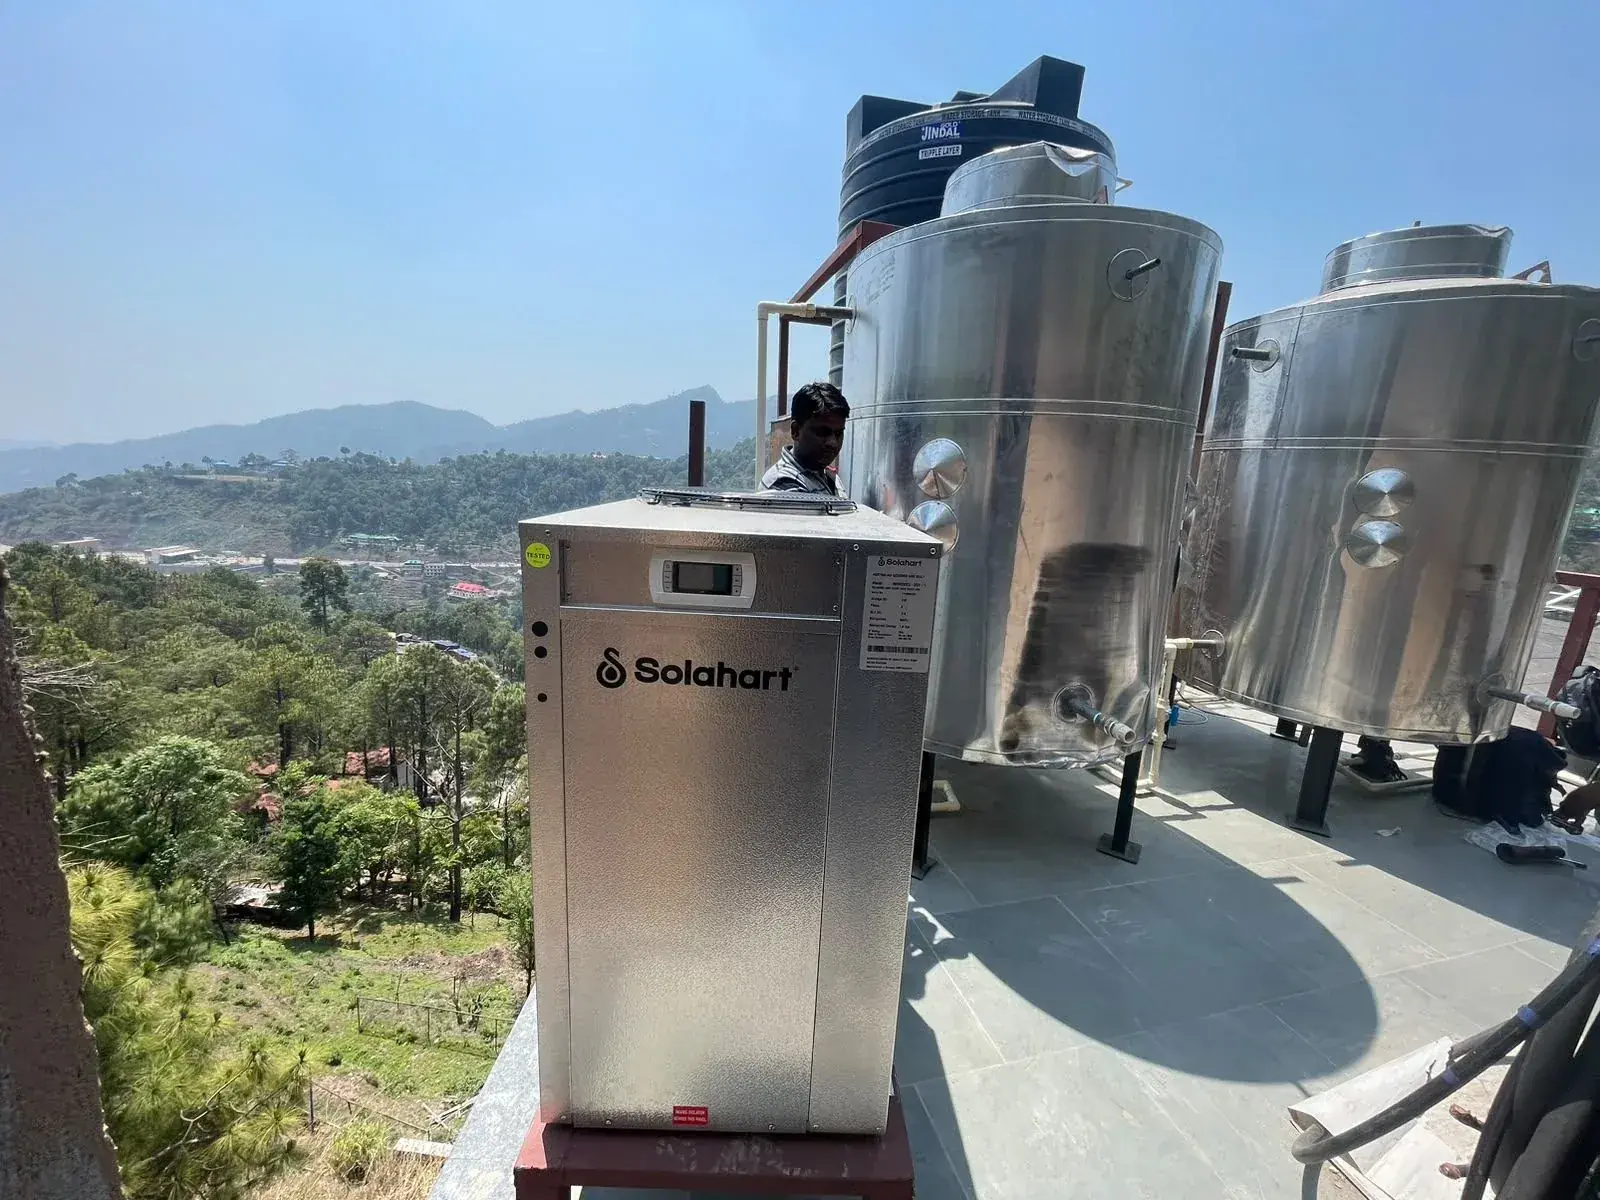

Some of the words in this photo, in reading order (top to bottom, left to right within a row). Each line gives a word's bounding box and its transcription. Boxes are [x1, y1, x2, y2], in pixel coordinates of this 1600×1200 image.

[1018, 111, 1035, 120] WATER
[921, 126, 960, 141] JINDAL
[922, 147, 943, 158] TRIPPLE
[943, 145, 961, 156] LAYER
[526, 551, 551, 560] TESTED
[886, 558, 922, 567] Solahart
[634, 656, 793, 691] Solahart
